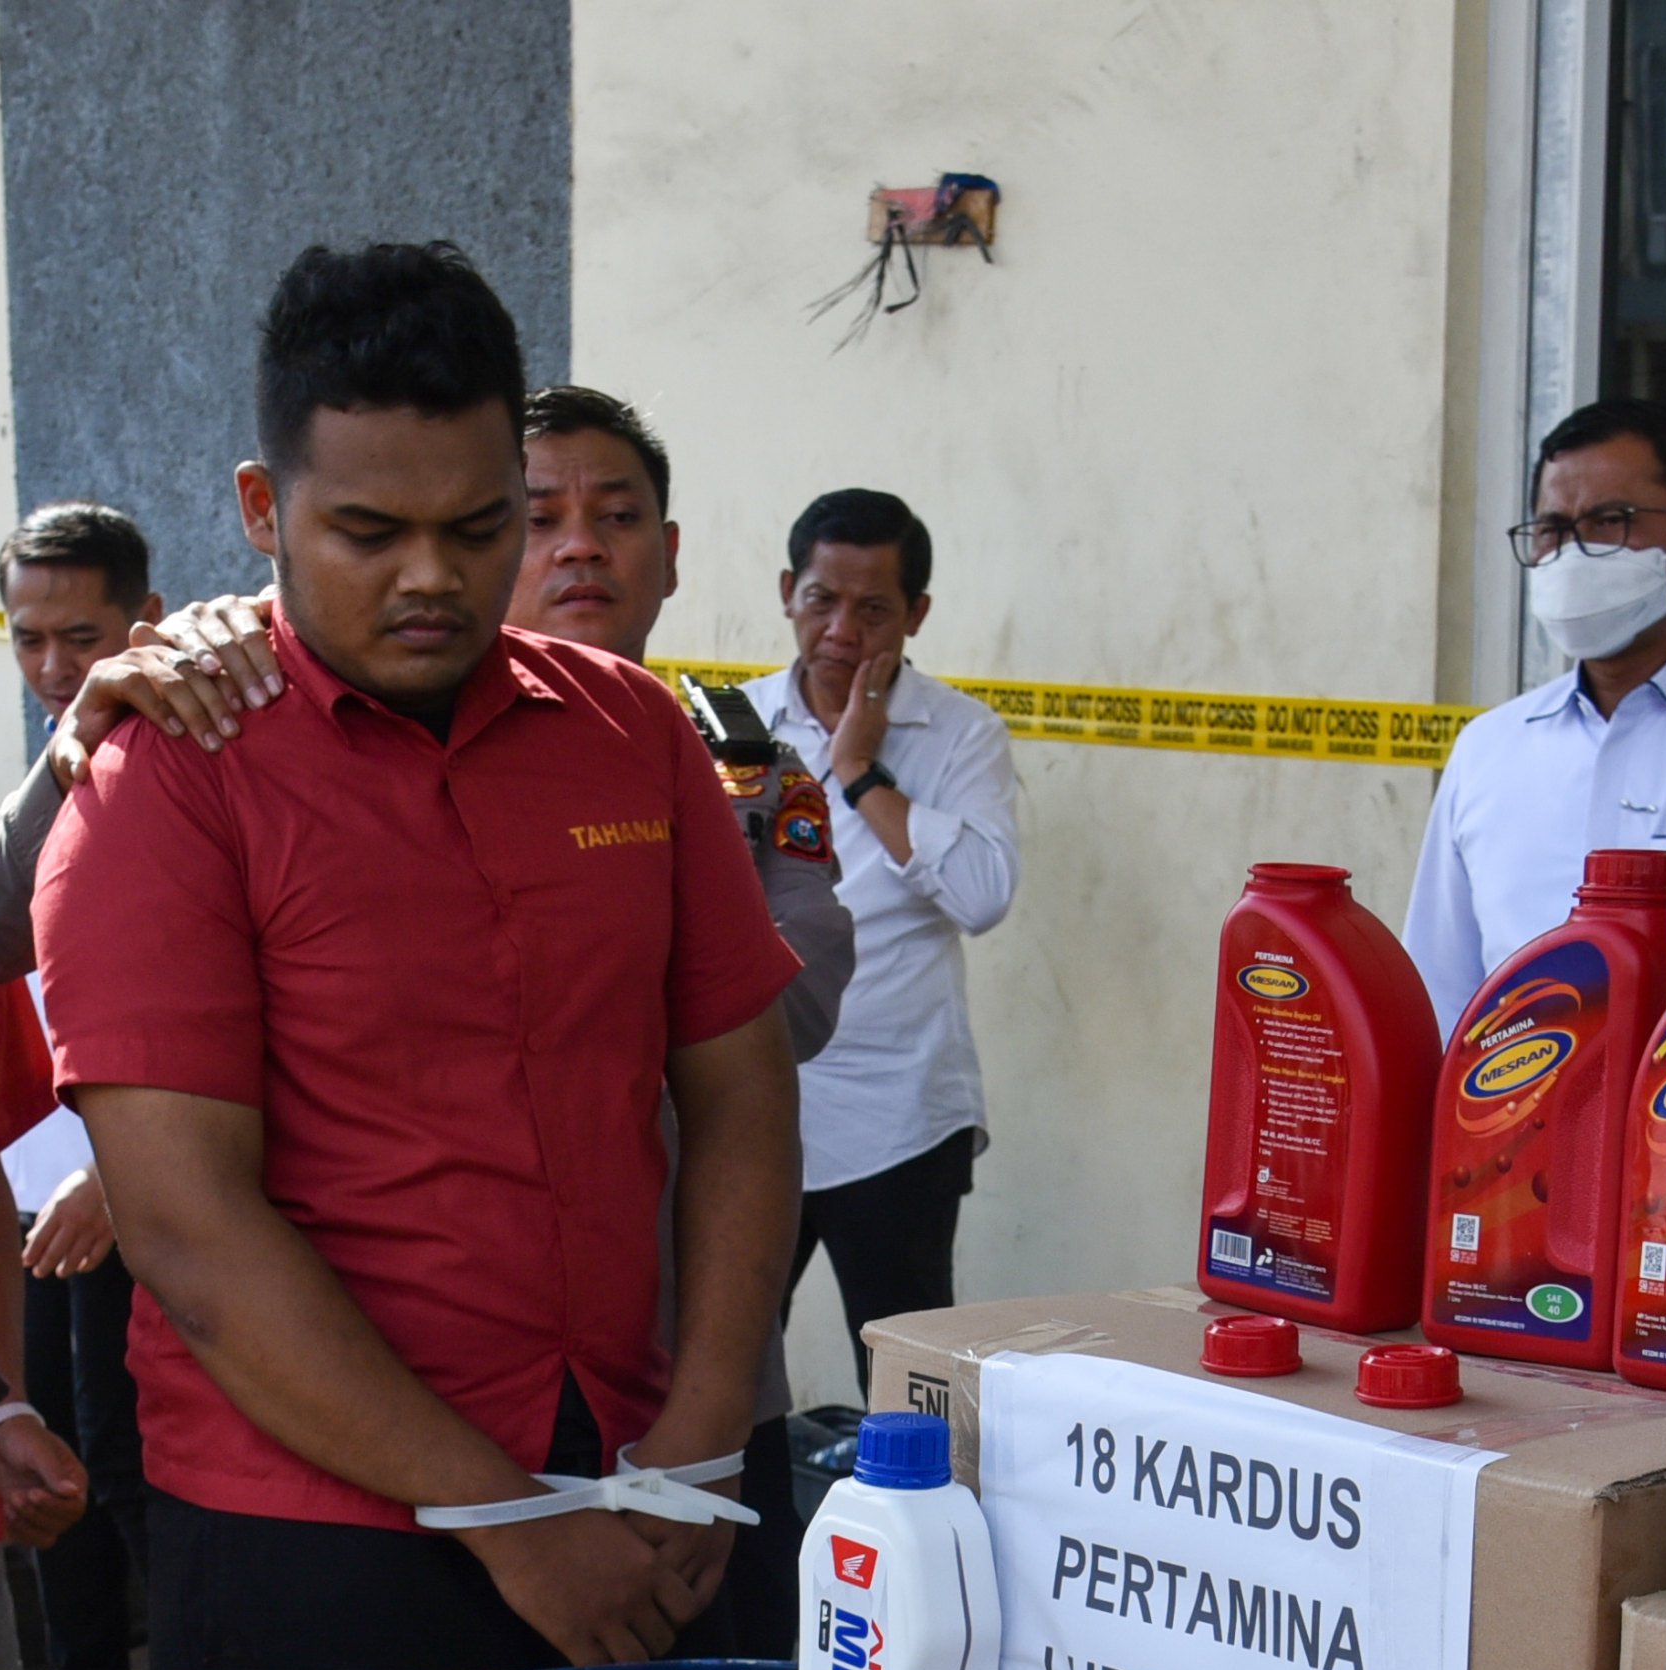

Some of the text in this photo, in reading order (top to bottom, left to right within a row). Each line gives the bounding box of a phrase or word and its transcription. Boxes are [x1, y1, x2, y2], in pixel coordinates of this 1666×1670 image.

[1095, 694, 1142, 725] CROSS
[1151, 698, 1171, 726] DO
[1175, 699, 1204, 728] NOT
[1207, 702, 1257, 731] CROSS
[1265, 705, 1288, 733] DO
[1291, 706, 1323, 735] NOT
[1326, 709, 1379, 739] CROSS
[1390, 712, 1414, 741] DO
[1417, 713, 1454, 743] NOT
[1255, 951, 1294, 964] PERTAMINA
[1249, 974, 1296, 989] MESRAN
[1480, 1018, 1535, 1051] PERTAMINA
[1480, 1044, 1553, 1086] MESRAN
[1546, 1294, 1562, 1304] SAE
[1548, 1305, 1561, 1316] 40
[1066, 1422, 1361, 1551] 18 KARDUS
